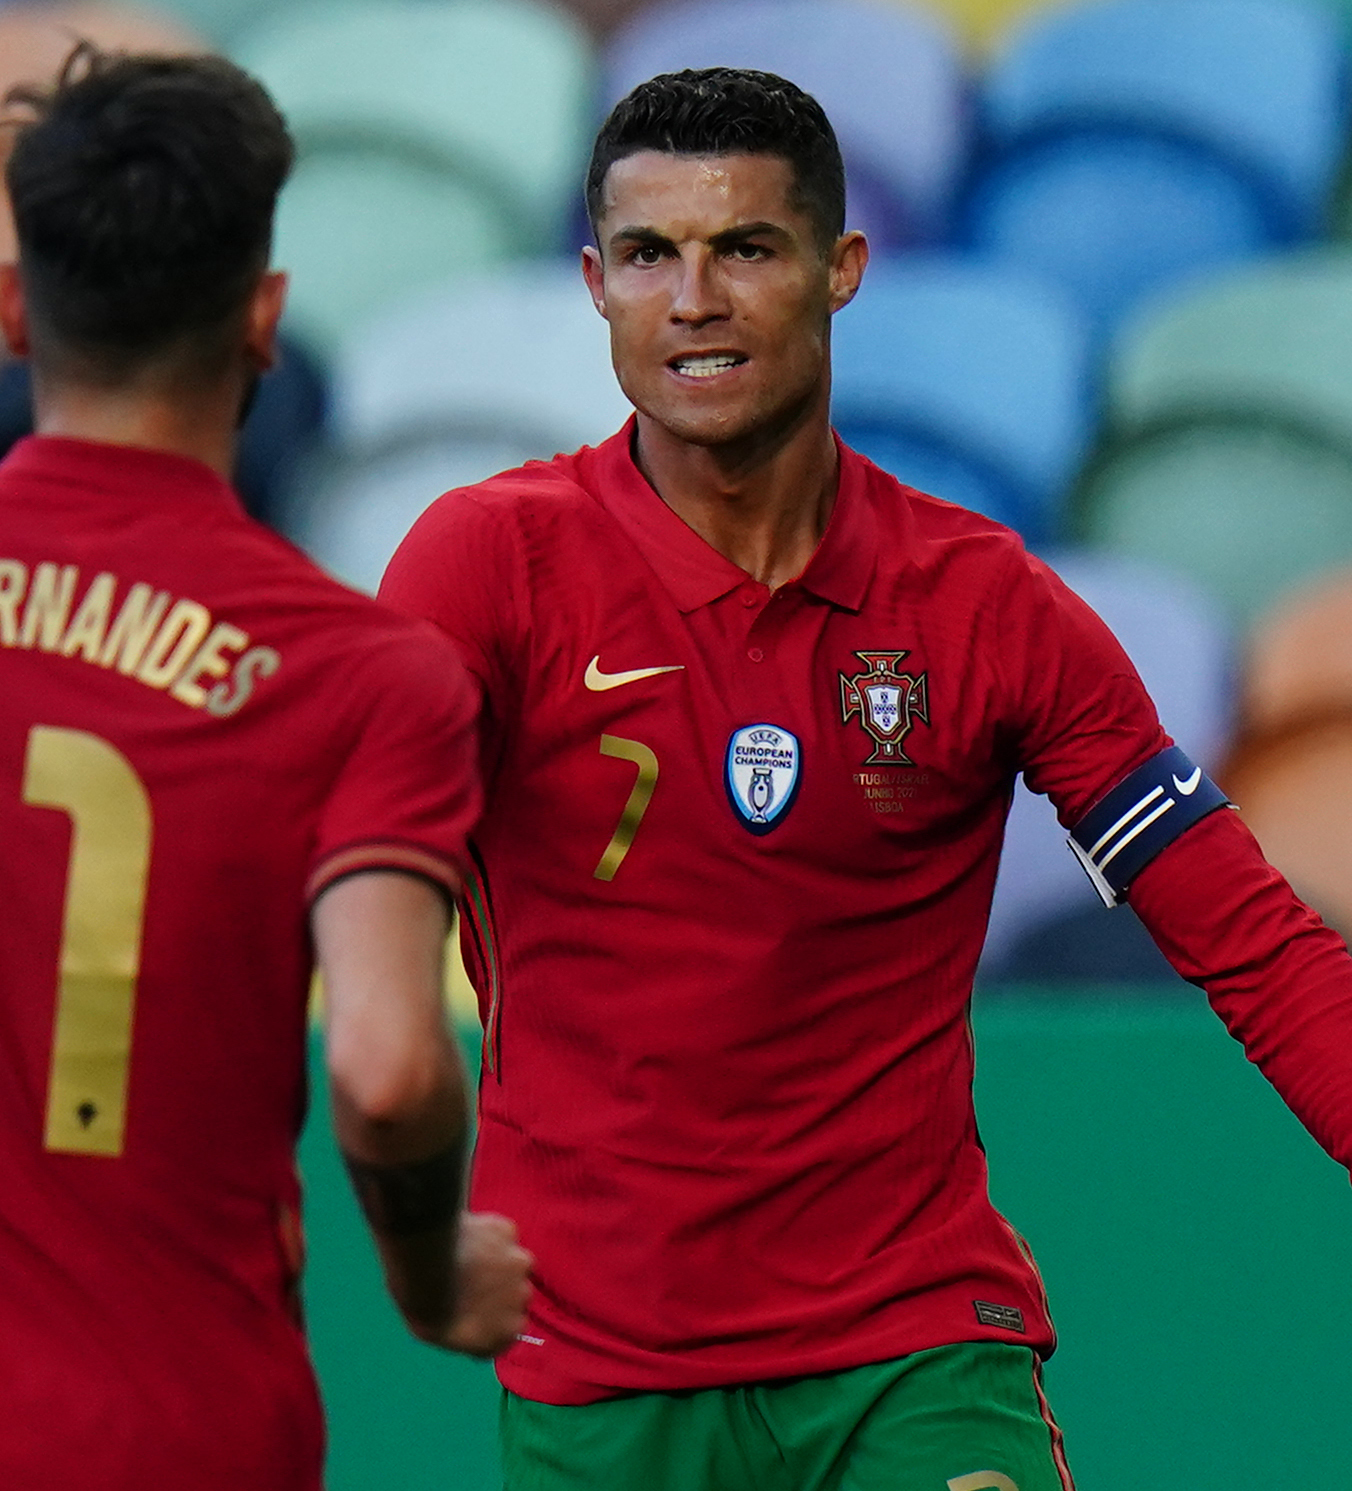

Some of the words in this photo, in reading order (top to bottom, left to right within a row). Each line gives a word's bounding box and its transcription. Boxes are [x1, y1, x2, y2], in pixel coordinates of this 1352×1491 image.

[750, 732, 780, 744] UEFA
[735, 746, 793, 759] EUROPEAN
[734, 756, 792, 768] CHAMPIONS
[593, 733, 659, 882] 7
